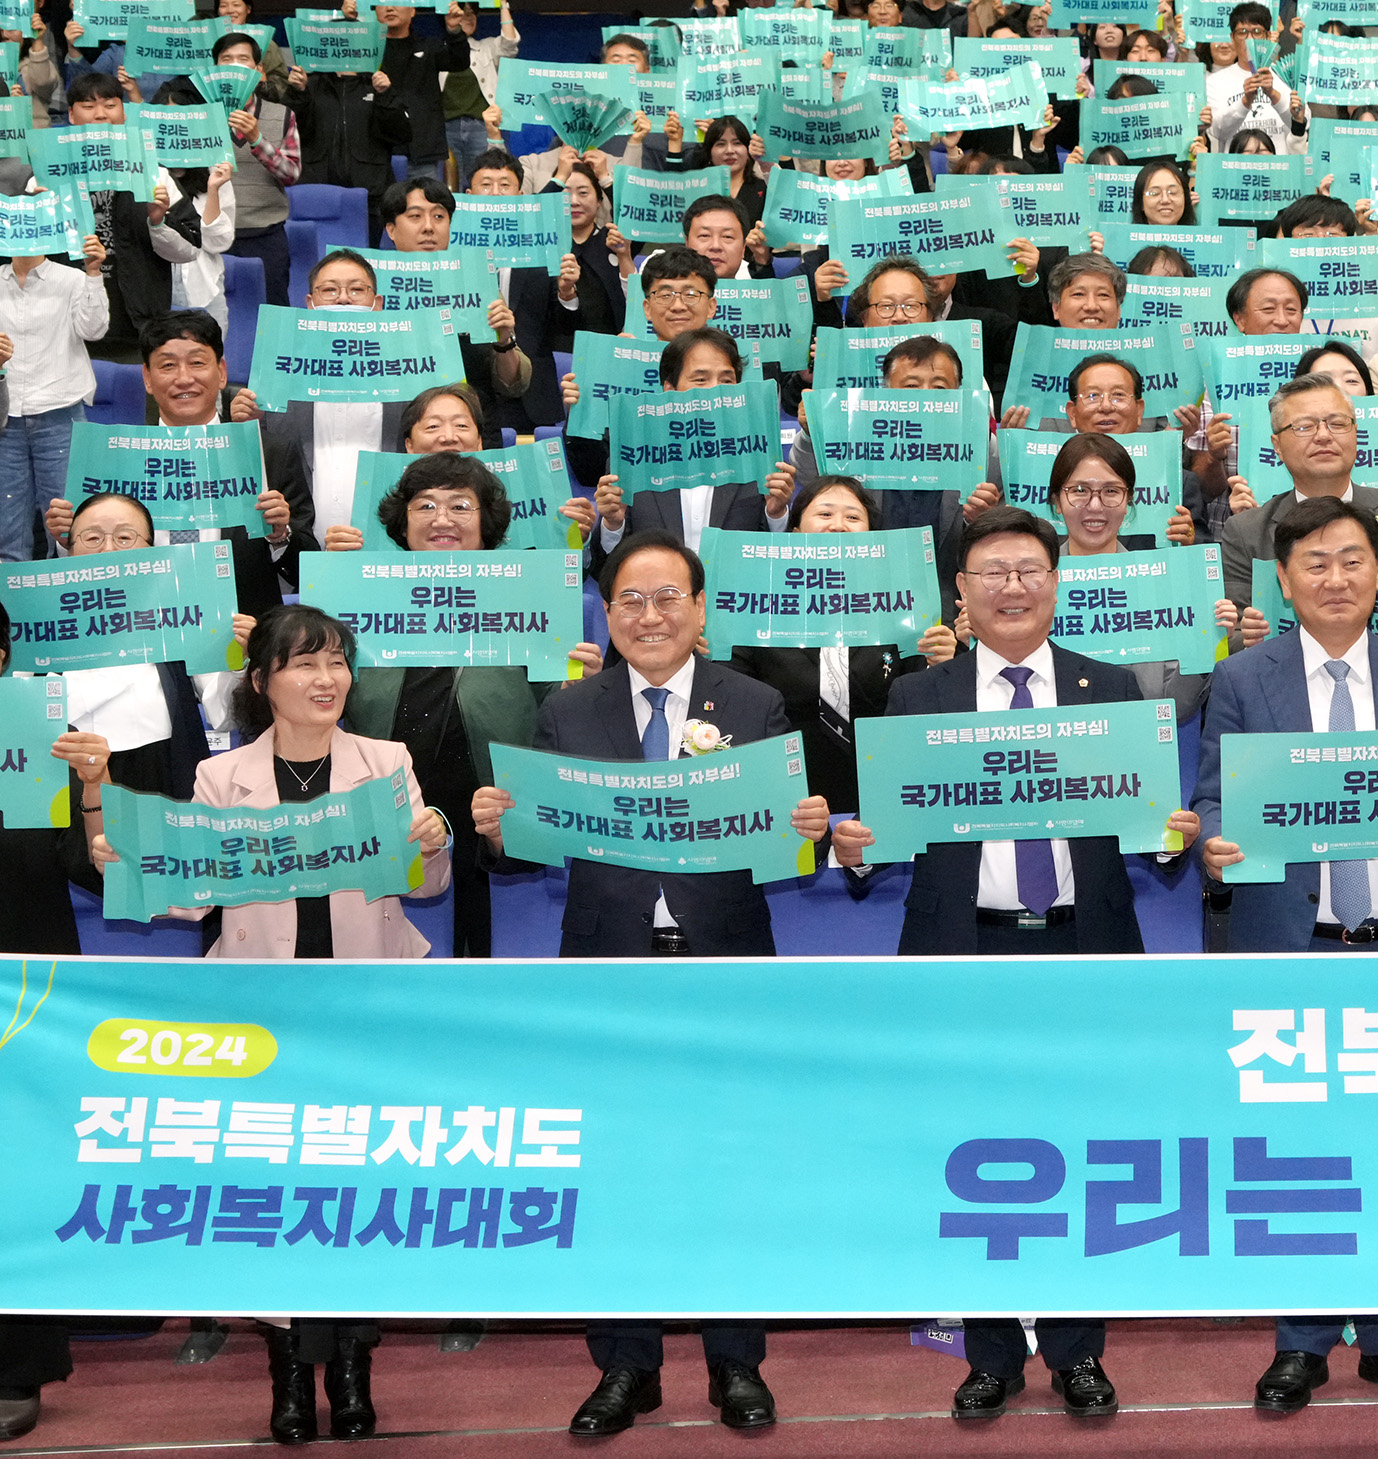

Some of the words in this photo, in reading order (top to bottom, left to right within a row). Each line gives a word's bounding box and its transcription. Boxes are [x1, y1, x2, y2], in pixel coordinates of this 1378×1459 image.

[298, 320, 376, 333] 전북특별자치도의
[379, 321, 413, 333] 자부심!
[332, 340, 380, 356] 우리는
[276, 356, 343, 376] 국가대표
[349, 356, 435, 377] 사회복지사
[714, 395, 745, 408] 자부심!
[841, 397, 919, 416] 전북특별자치도의
[923, 401, 958, 413] 자부심!
[669, 418, 716, 439] 우리는
[873, 420, 922, 438] 우리는
[109, 437, 191, 450] 전북특별자치도의
[195, 432, 229, 452] 자부심!
[619, 443, 683, 466] 국가대표
[688, 435, 768, 460] 사회복지사
[825, 442, 884, 460] 국가대표
[890, 443, 973, 462] 사회복지사
[144, 458, 196, 477] 우리는
[163, 477, 257, 501] 사회복지사
[742, 545, 841, 560] 전북특별자치도의
[845, 545, 885, 558] 자부심!
[8, 565, 120, 588] 전북특별자치도의
[124, 559, 171, 576] 자부심!
[362, 561, 472, 581] 전북특별자치도의
[476, 564, 521, 577] 자부심!
[785, 568, 845, 589] 우리는
[1125, 562, 1166, 577] 자부심!
[60, 588, 126, 614] 우리는
[411, 587, 476, 608] 우리는
[716, 592, 799, 615] 국가대표
[807, 590, 914, 615] 사회복지사
[1069, 588, 1127, 610] 우리는
[85, 605, 202, 636] 사회복지사
[434, 612, 548, 633] 사회복지사
[1090, 607, 1194, 634] 사회복지사
[926, 723, 1052, 745] 전북특별자치도의
[1057, 720, 1108, 737] 자부심!
[983, 750, 1057, 776] 우리는
[558, 768, 683, 789] 전북특별자치도의
[689, 763, 740, 785] 자부심!
[901, 781, 1002, 807] 국가대표
[1010, 773, 1141, 803] 사회복지사
[166, 813, 288, 832] 전북특별자치도의
[295, 804, 346, 825] 자부심!
[614, 796, 689, 817] 우리는
[1263, 800, 1360, 827] 국가대표
[537, 805, 637, 839] 국가대표
[639, 806, 773, 842] 사회복지사
[141, 855, 243, 879] 국가대표
[247, 836, 381, 877] 사회복지사
[221, 836, 296, 857] 우리는
[116, 1027, 247, 1068] 2024
[72, 1096, 583, 1170] 전북특별자치도
[940, 1138, 1361, 1260] 우리는
[55, 1183, 579, 1251] 사회복지사대회
